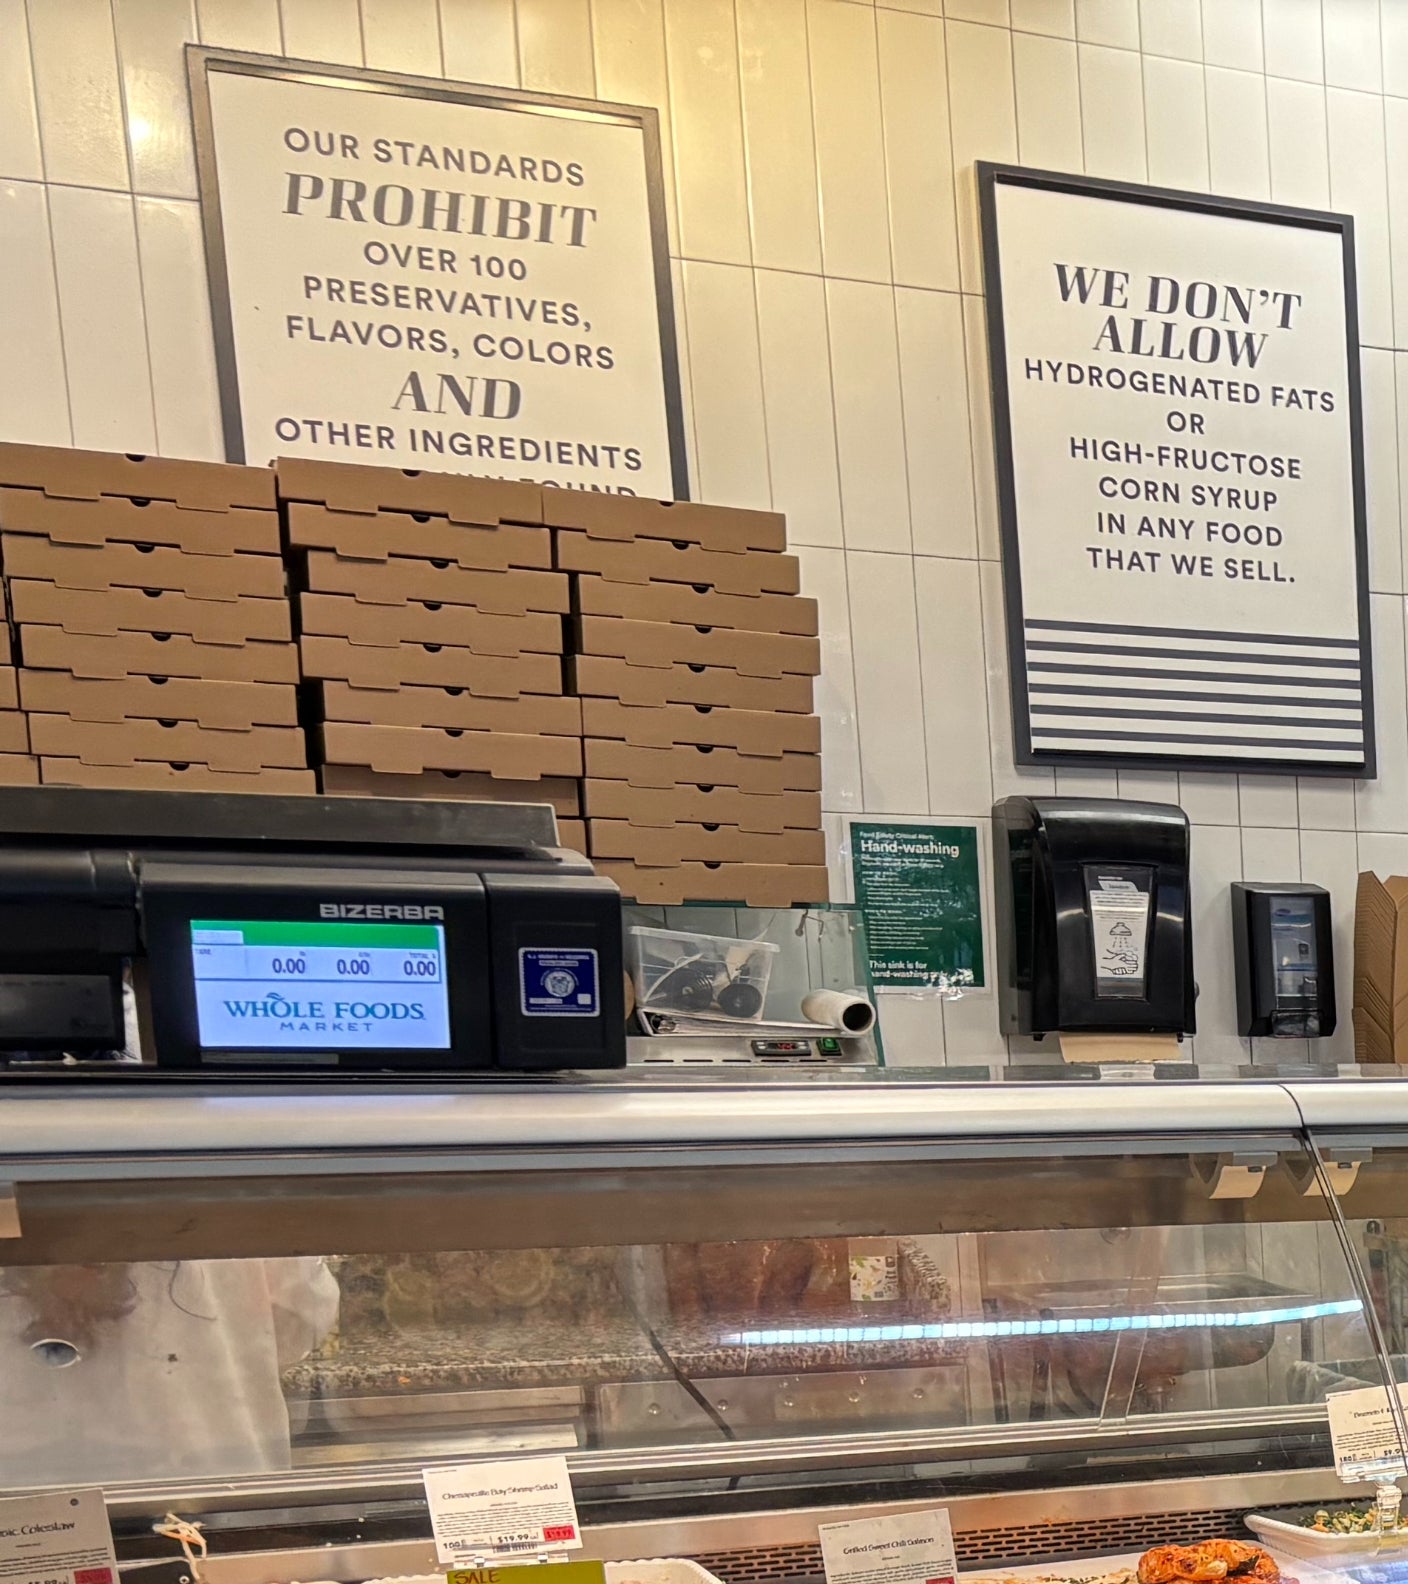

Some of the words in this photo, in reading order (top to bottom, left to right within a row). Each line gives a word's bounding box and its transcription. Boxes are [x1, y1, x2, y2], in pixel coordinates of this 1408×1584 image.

[285, 128, 359, 159] OUR
[374, 139, 585, 186] STANDARDS
[282, 172, 597, 247] PROHIBIT
[364, 241, 458, 273] OVER
[471, 256, 527, 280] 100
[305, 276, 592, 331] PRESERVATIVES,
[1055, 263, 1129, 309] WE
[1147, 275, 1302, 330] DON'T
[286, 315, 460, 358] FLAVORS,
[473, 334, 615, 369] COLORS
[1093, 314, 1268, 369] ALLOW
[391, 370, 522, 420] AND
[1025, 359, 1260, 403] HYDROGENATED
[1271, 386, 1335, 412] FATS
[1167, 411, 1205, 434] OR
[275, 417, 396, 450] OTHER
[411, 428, 642, 471] INGREDIENTS
[1070, 438, 1302, 479] HIGH-FRUCTOSE
[1098, 476, 1180, 504] CORN
[1191, 486, 1278, 512] SYRUP
[1098, 512, 1126, 535] IN
[1137, 517, 1195, 541] ANY
[1206, 522, 1283, 547] FOOD
[1086, 547, 1162, 574] THAT
[1171, 554, 1213, 577] WE
[1224, 558, 1295, 582] SELL.
[861, 840, 959, 858] Hand-washing
[320, 904, 444, 920] BIZERBA
[272, 958, 306, 974] 0.00
[337, 959, 369, 975] 0.00
[404, 960, 436, 976] 0.00
[888, 961, 905, 969] sink
[906, 961, 914, 969] is
[915, 961, 927, 969] for
[223, 992, 324, 1018] WHOLE
[335, 1002, 427, 1020] FOODS
[280, 1022, 373, 1031] MARKET
[498, 1533, 529, 1543] $19.99
